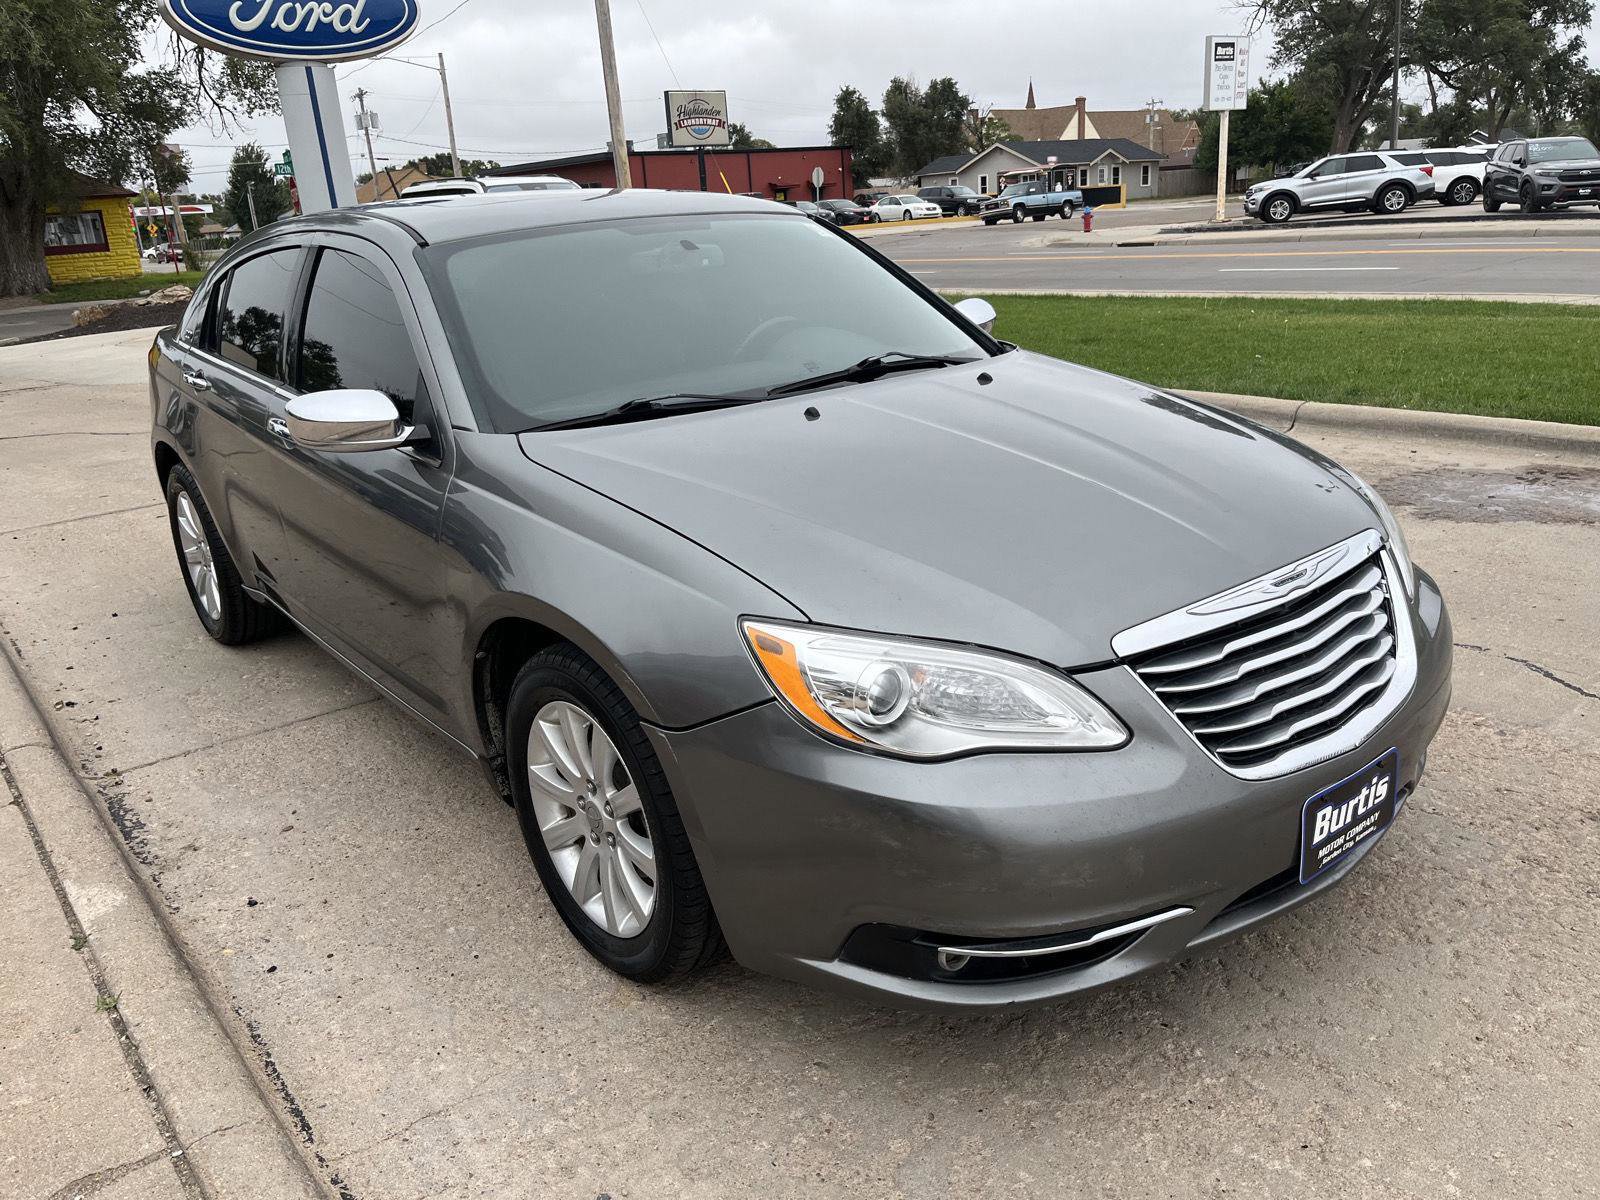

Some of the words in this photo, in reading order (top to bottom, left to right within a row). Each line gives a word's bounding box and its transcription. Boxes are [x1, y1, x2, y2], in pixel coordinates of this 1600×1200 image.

[277, 164, 292, 174] 12th
[1312, 775, 1390, 845] Burtis
[1317, 835, 1346, 860] MOTOR
[1345, 810, 1381, 840] COMPANY
